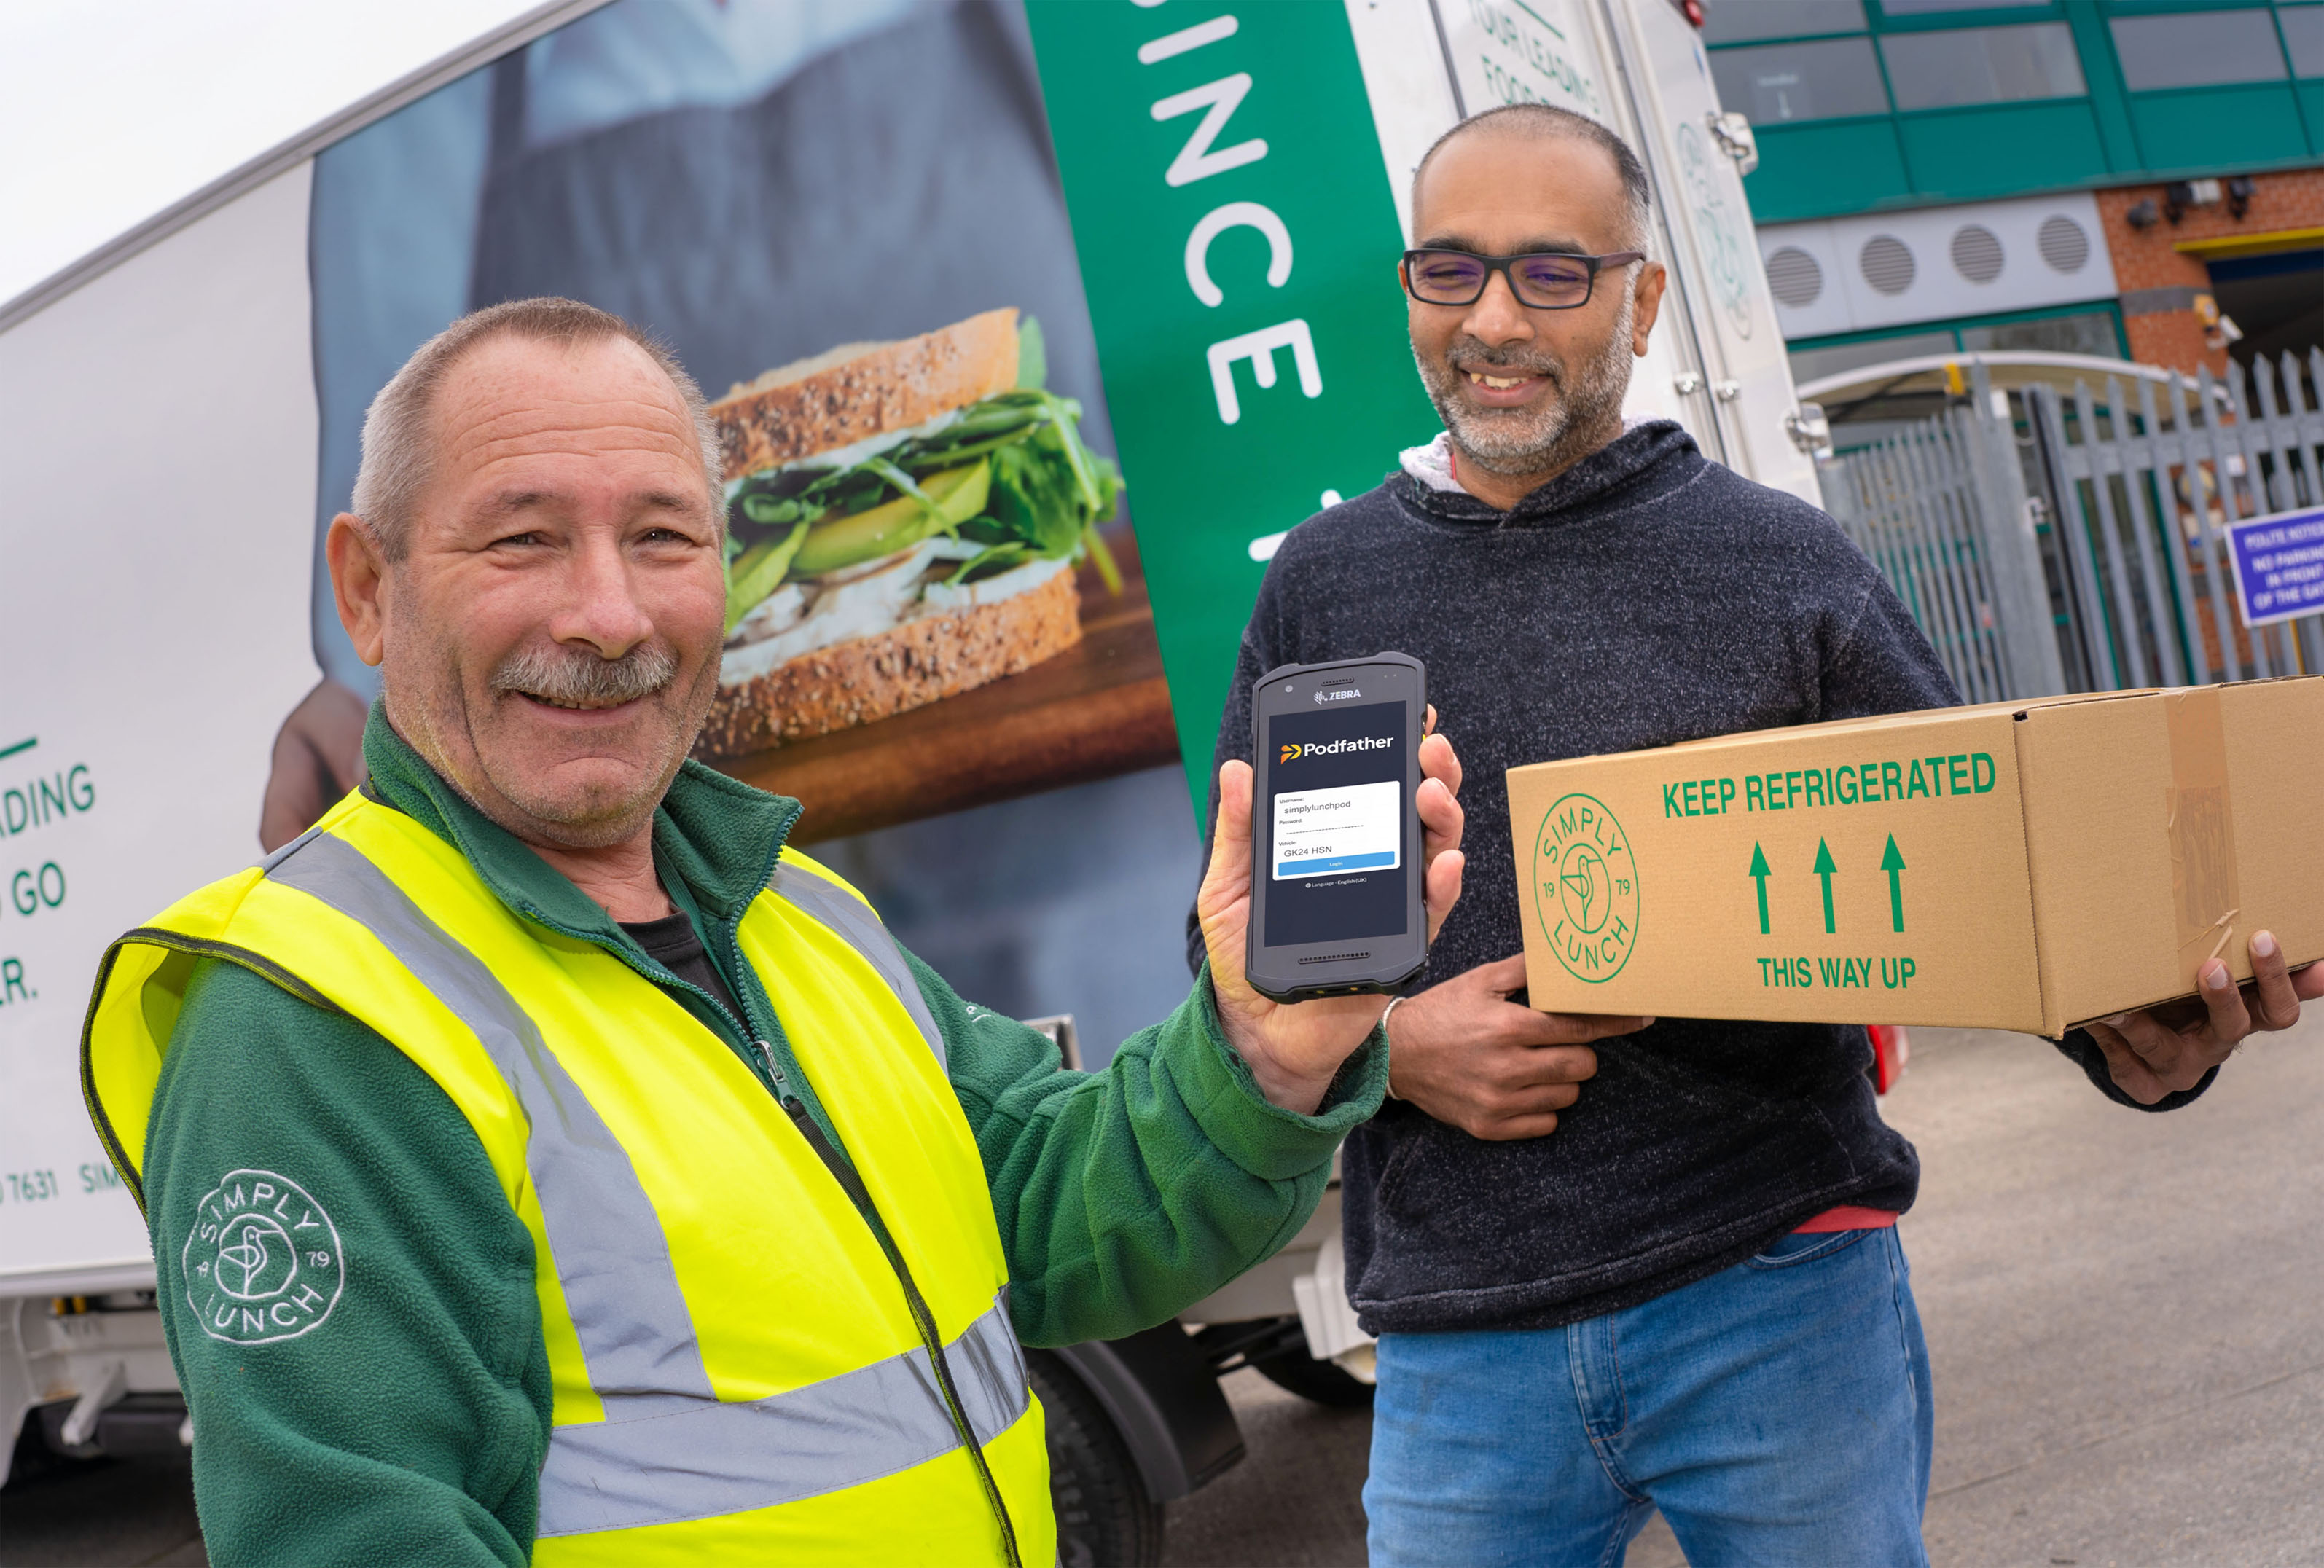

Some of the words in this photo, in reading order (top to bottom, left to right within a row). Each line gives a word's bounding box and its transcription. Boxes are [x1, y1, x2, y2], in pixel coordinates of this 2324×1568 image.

[1129, 0, 1323, 425] INCE
[1329, 689, 1361, 701] ZEBRA
[1304, 737, 1394, 756] Podfather
[1662, 777, 1736, 818] KEEP
[1745, 751, 1996, 812] REFRIGERATED
[1284, 801, 1351, 814] simplylunchpod
[1284, 848, 1309, 858] GK24
[1312, 846, 1332, 855] HSN
[1544, 807, 1622, 864] SIMPLY
[12, 861, 66, 916] GO
[1543, 882, 1554, 898] 19
[1616, 879, 1630, 895] 79
[1554, 915, 1629, 970] LUNCH
[1757, 957, 1812, 988] THIS
[1818, 957, 1871, 988] WAY
[1881, 957, 1916, 989] UP
[7, 1168, 59, 1202] 7631
[200, 1183, 320, 1243] SIMPLY
[305, 1251, 330, 1267] 79
[205, 1283, 324, 1333] LUNCH
